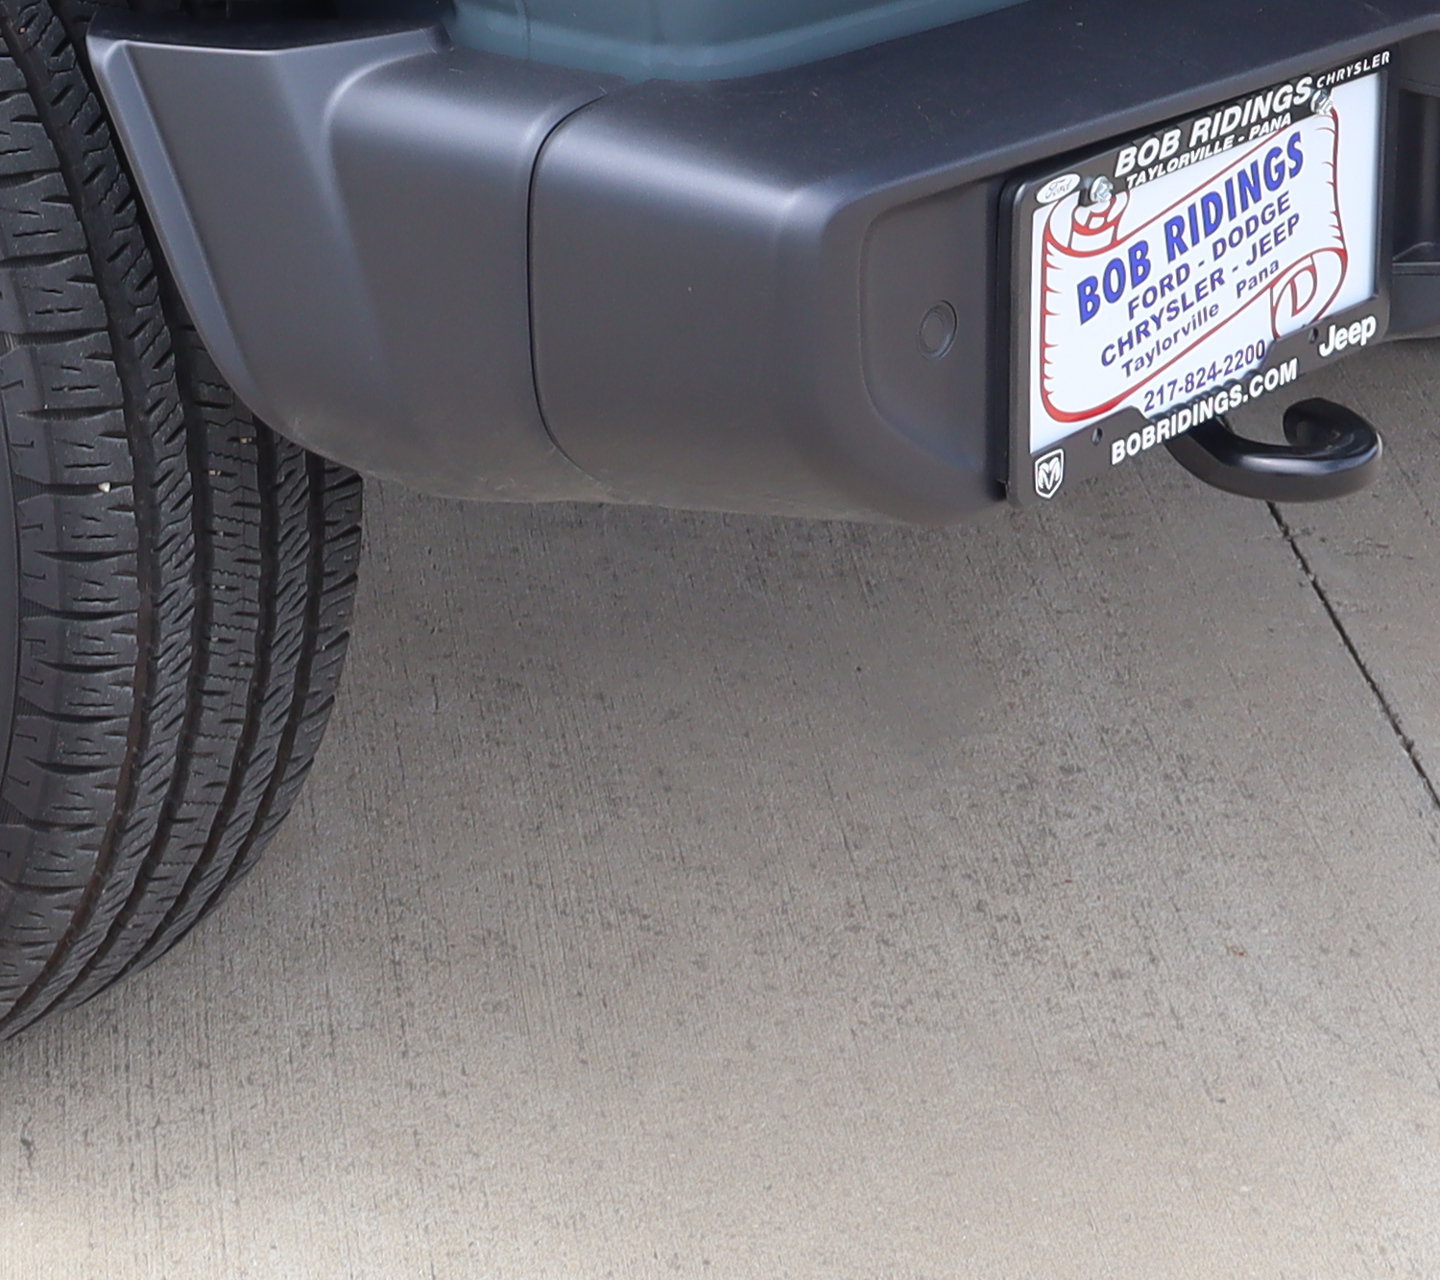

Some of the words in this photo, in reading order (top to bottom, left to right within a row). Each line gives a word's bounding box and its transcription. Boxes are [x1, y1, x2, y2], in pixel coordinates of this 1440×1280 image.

[1316, 51, 1391, 89] CHRYSLER
[1114, 126, 1179, 178] BOB
[1189, 76, 1313, 149] RIDINGS
[1126, 140, 1234, 189] TAYLORVILLE
[1250, 115, 1293, 142] PANA
[1076, 238, 1151, 326] BOB
[1162, 131, 1304, 263] RIDINGS
[1127, 263, 1192, 320] FORD
[1213, 191, 1292, 257] DODGE
[1100, 267, 1226, 368] CHRYSLER
[1245, 211, 1301, 269] JEEP
[1121, 302, 1220, 379] Taylorville
[1235, 258, 1281, 300] Pana
[1318, 315, 1377, 357] Jeep
[1111, 358, 1299, 465] BOBRIDINGS.COM
[1143, 339, 1267, 413] 217-824-2200
